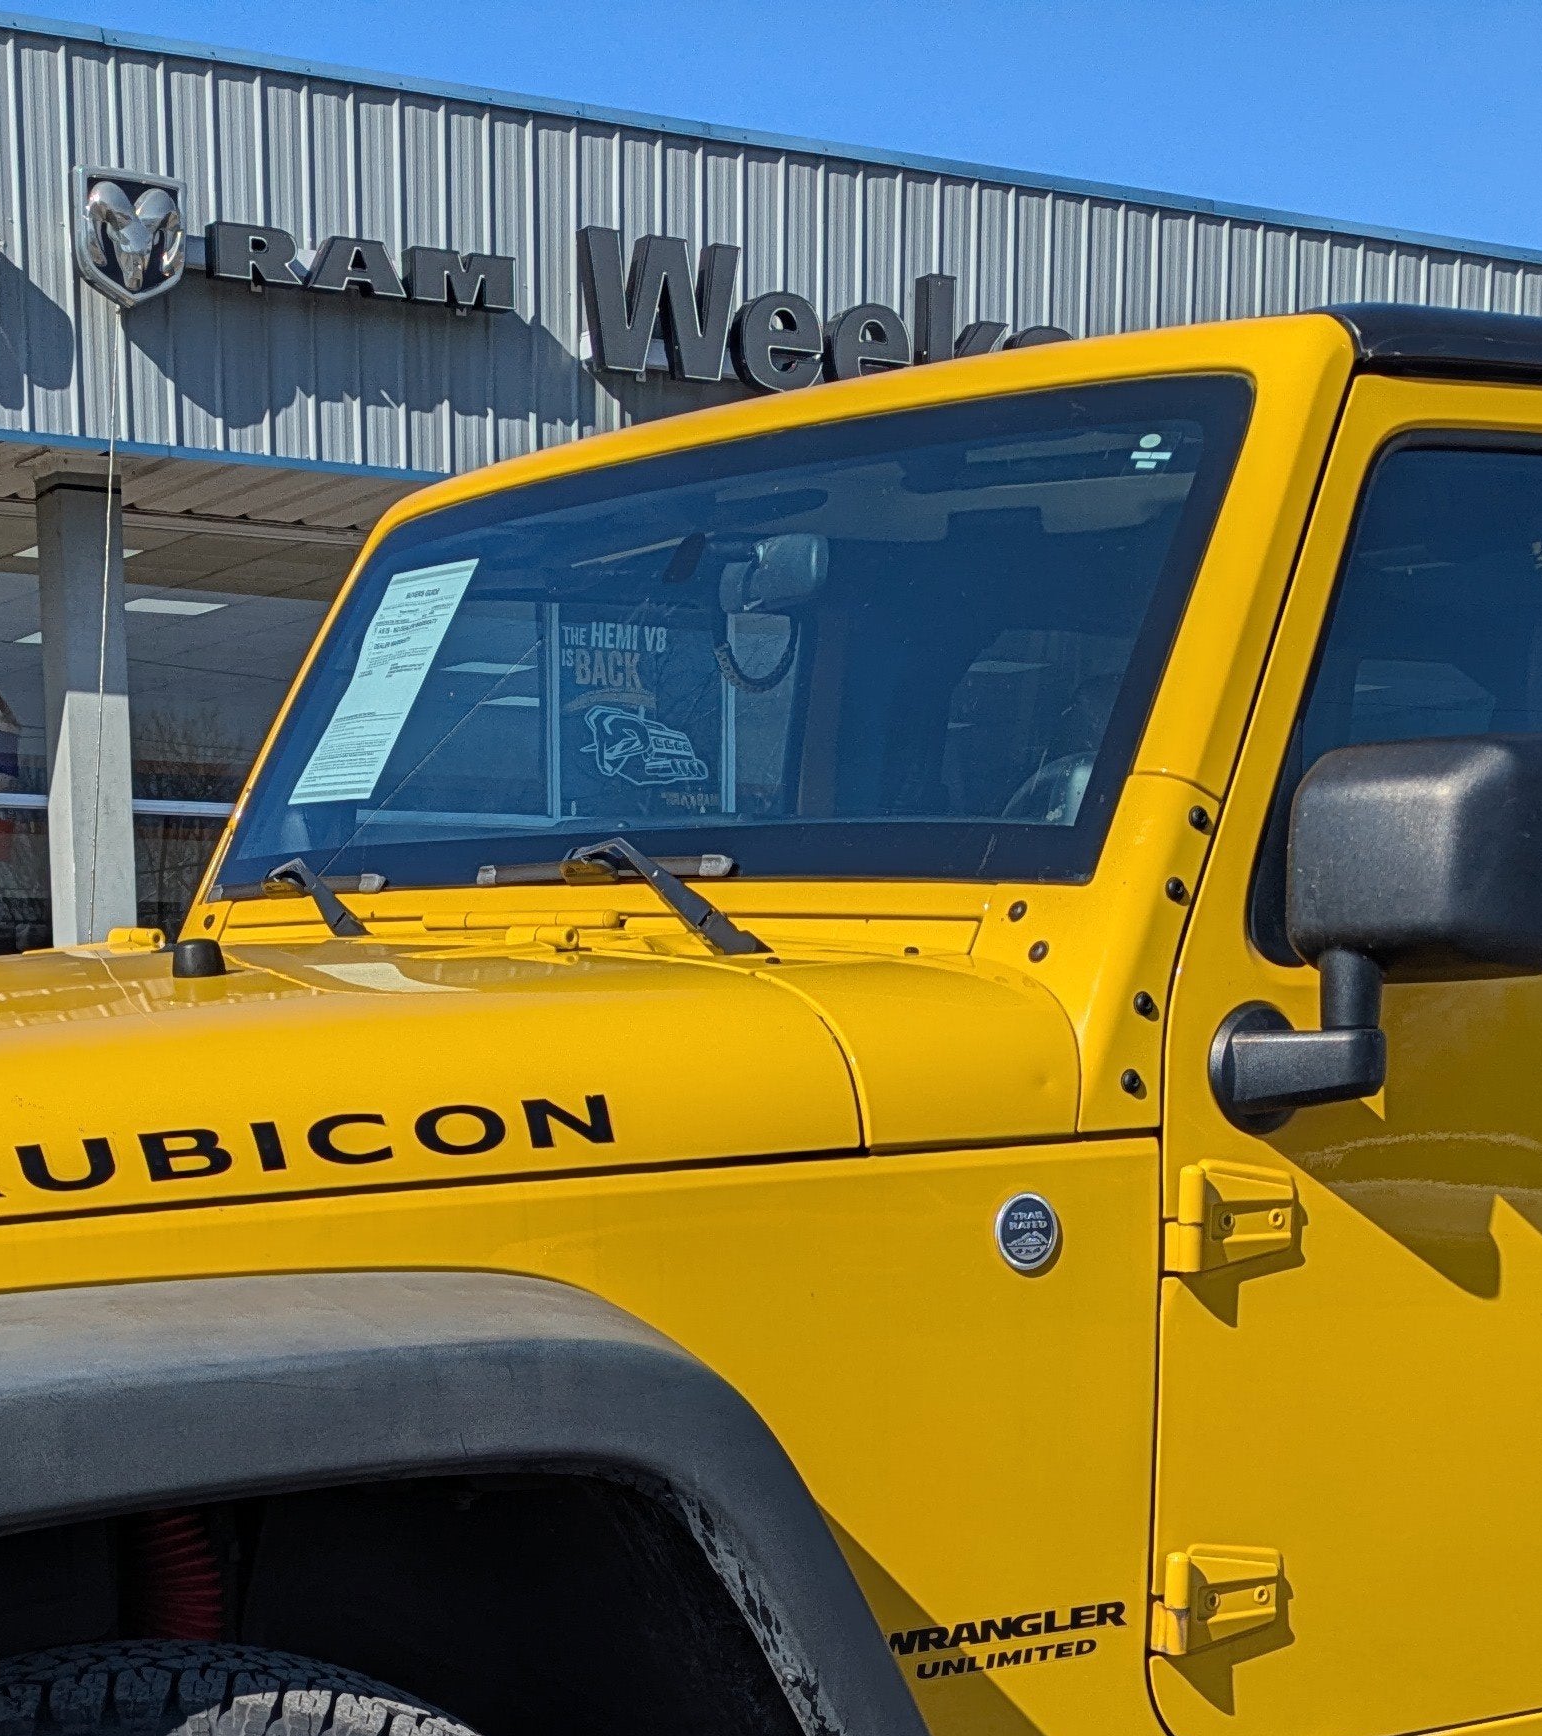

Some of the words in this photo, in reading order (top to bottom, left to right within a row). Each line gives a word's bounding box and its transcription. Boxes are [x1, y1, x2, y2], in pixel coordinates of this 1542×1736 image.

[205, 219, 516, 314] RAM
[561, 625, 587, 646] THE
[590, 621, 638, 650] HEMI
[643, 625, 667, 652] V8
[561, 648, 574, 667] IS
[575, 648, 643, 690] BACK
[1008, 1220, 1048, 1231] RATED
[1010, 1210, 1046, 1221] TRAIL
[885, 1601, 1128, 1656] WRANGLER
[915, 1639, 1097, 1680] UNLIMITED
